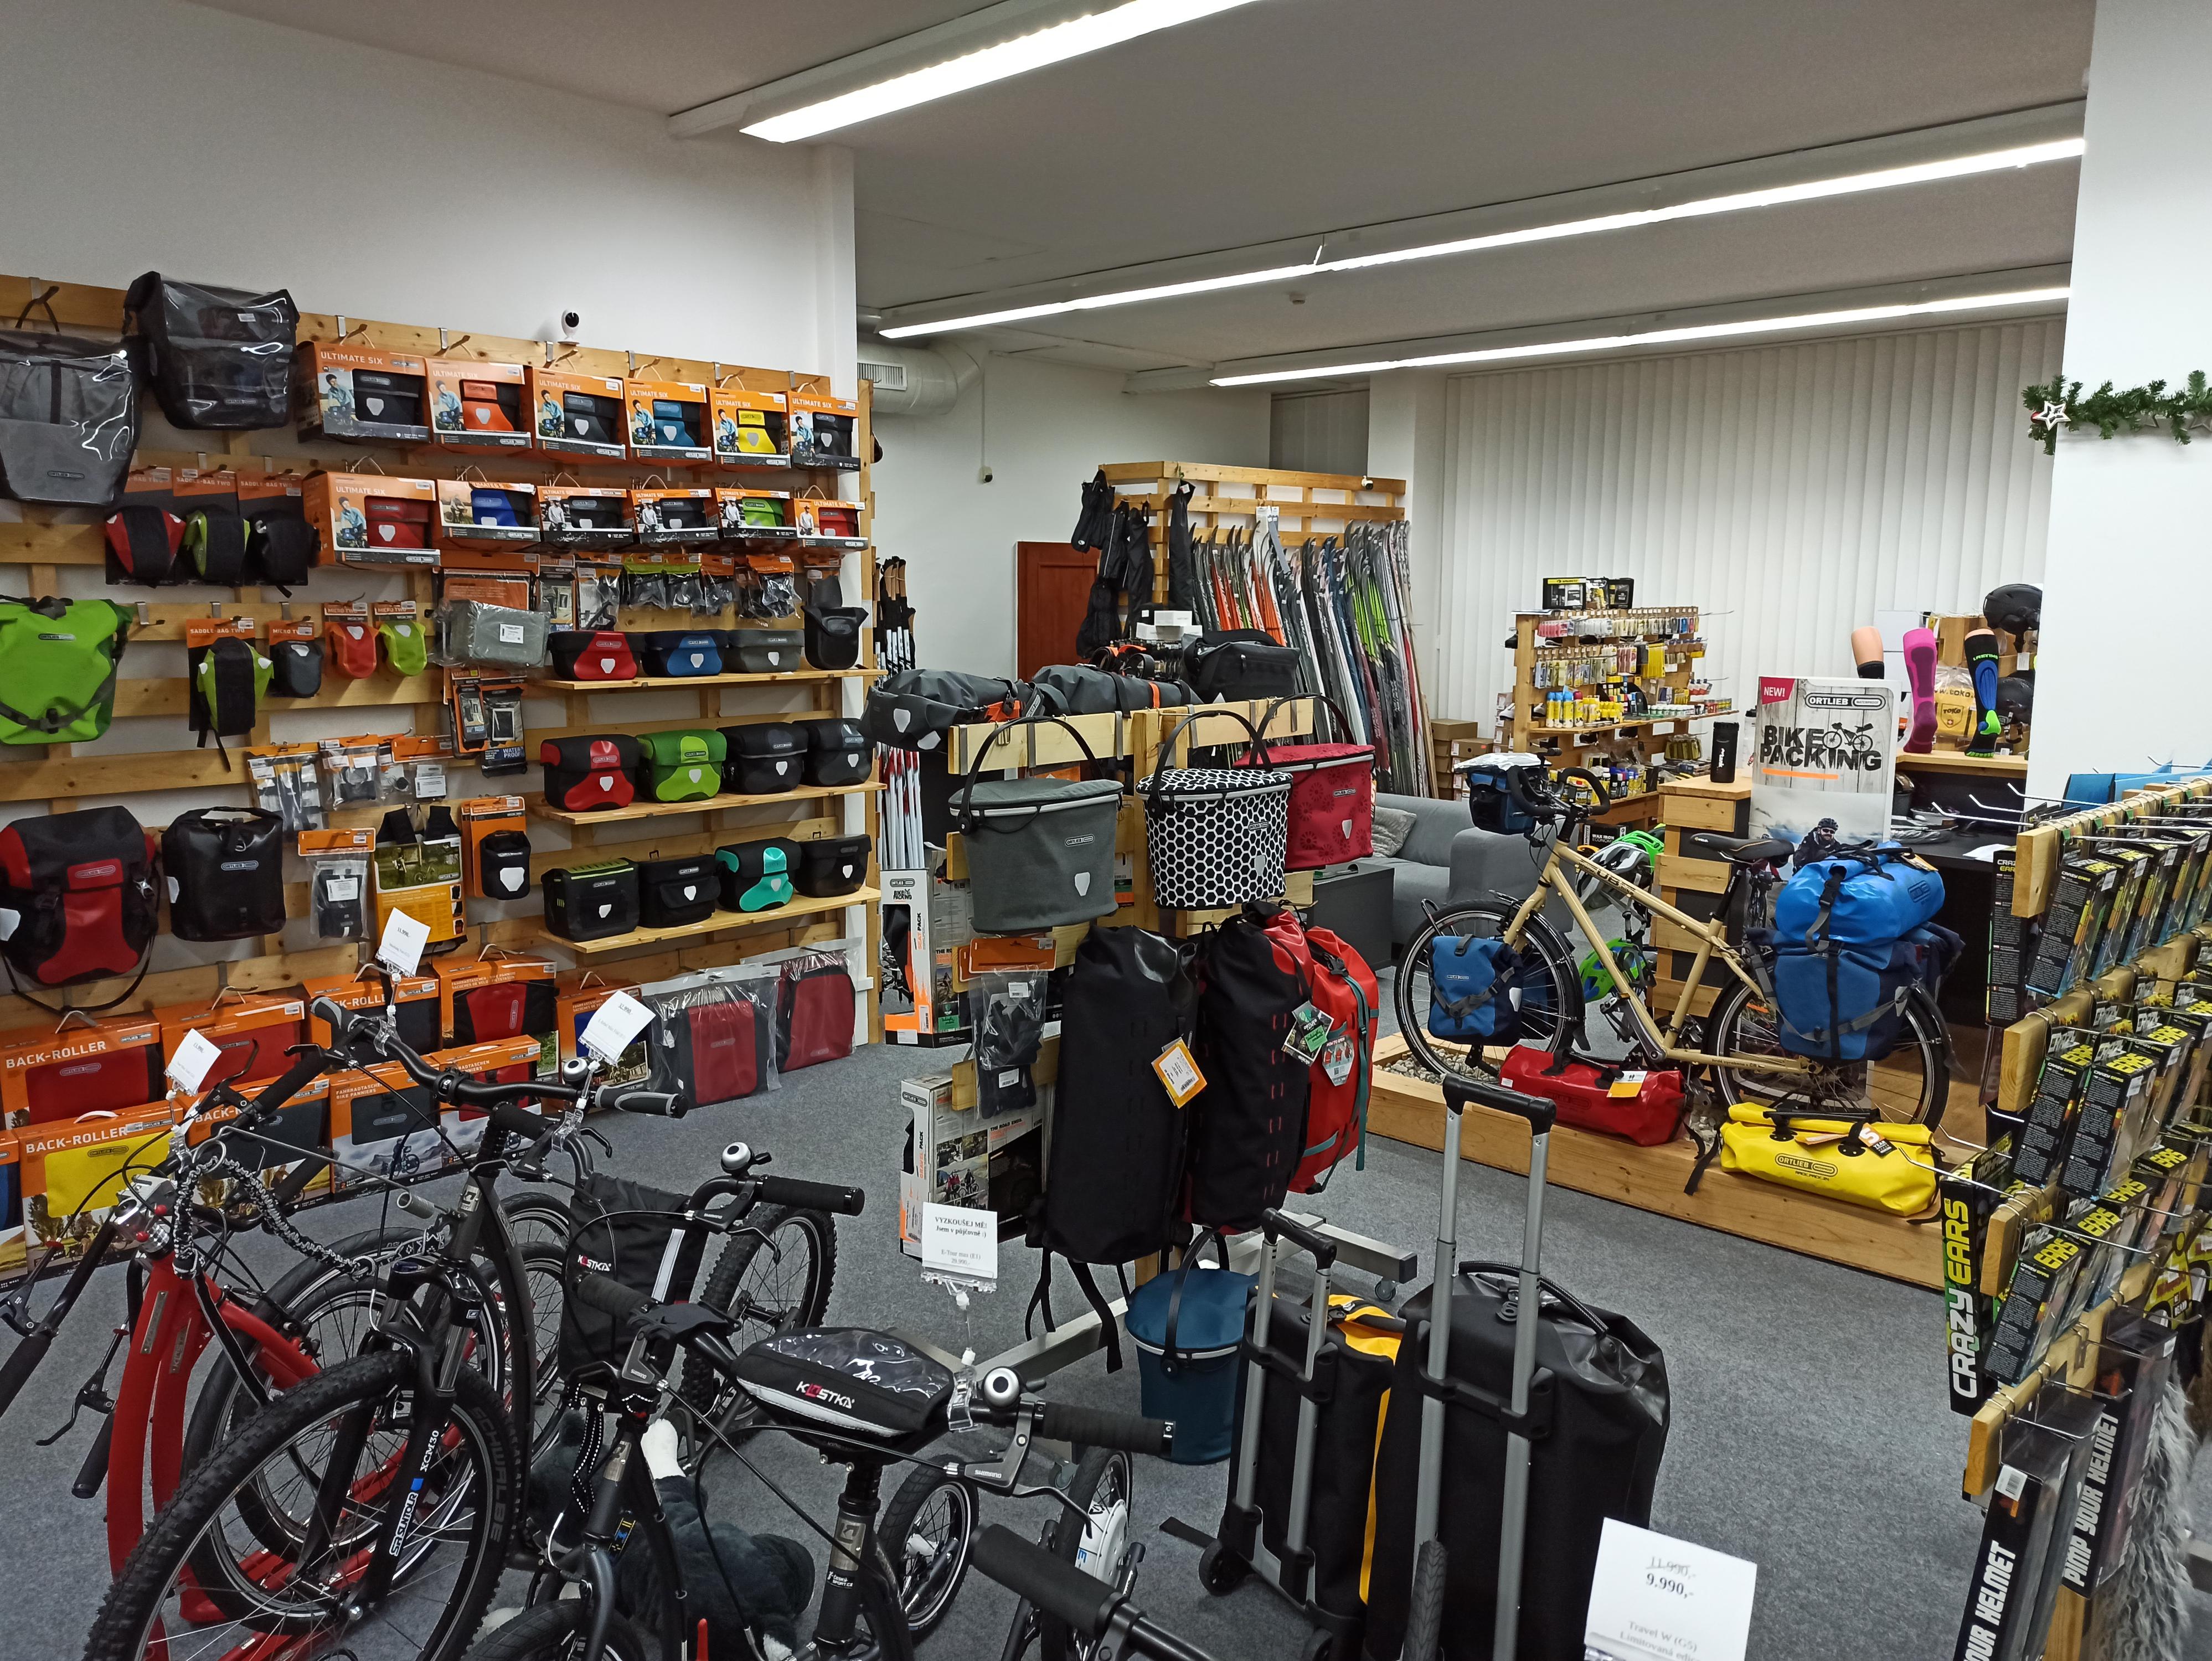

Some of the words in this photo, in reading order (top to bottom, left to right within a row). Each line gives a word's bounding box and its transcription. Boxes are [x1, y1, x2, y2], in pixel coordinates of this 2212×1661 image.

[321, 351, 364, 363] ULTIMATE
[368, 355, 383, 365] SIX
[539, 379, 569, 388] ULTIMATE
[570, 381, 581, 390] SIX
[792, 398, 821, 408] ULTIMATE
[1764, 687, 1785, 697] NEW!
[1809, 697, 1849, 705] ORTLIEB
[1764, 725, 1824, 749] BIKE
[1760, 742, 1881, 771] PACKING
[2061, 870, 2078, 879] CRAZY
[2147, 1025, 2188, 1045] EARS
[6, 1041, 106, 1069] BACK-ROLLER
[2106, 1053, 2153, 1074] EARS
[2047, 1062, 2064, 1071] CRAZY
[2093, 1070, 2110, 1079] CRAZY
[350, 1088, 377, 1098] PANNIERS
[26, 1126, 127, 1154] BACK-ROLLER
[1860, 1127, 1880, 1144] 5
[1778, 1157, 1809, 1168] ORTLIEB
[2149, 1148, 2187, 1169] EARS
[935, 1216, 973, 1227] VYZKOUŠEJ
[956, 1227, 981, 1237] půjčovně
[2077, 1206, 2121, 1237] EARS
[1943, 1198, 1971, 1285] EARS
[578, 1254, 612, 1272] KOSTKA
[2034, 1237, 2079, 1269] EARS
[2020, 1262, 2035, 1272] CRAZY
[2035, 1268, 2050, 1278] EARS
[1948, 1287, 1977, 1399] CRAZY
[796, 1380, 855, 1409] KOSTKA
[2087, 1412, 2118, 1485] HELMET
[396, 1492, 419, 1537] SUNTOUR
[420, 1430, 439, 1472] XCM30
[471, 1407, 508, 1543] SCHWALBE
[974, 1469, 1002, 1479] SHIMANO
[2074, 1484, 2103, 1537] YOUR
[2064, 1534, 2091, 1587] PIMP
[1646, 1572, 1694, 1598] 9.990,-
[1974, 1539, 2016, 1626] HELMET
[1628, 1621, 1658, 1638] Travel
[1661, 1631, 1672, 1642] W
[1620, 1631, 1674, 1657] Limitovaná
[1963, 1624, 1997, 1661] OUR
